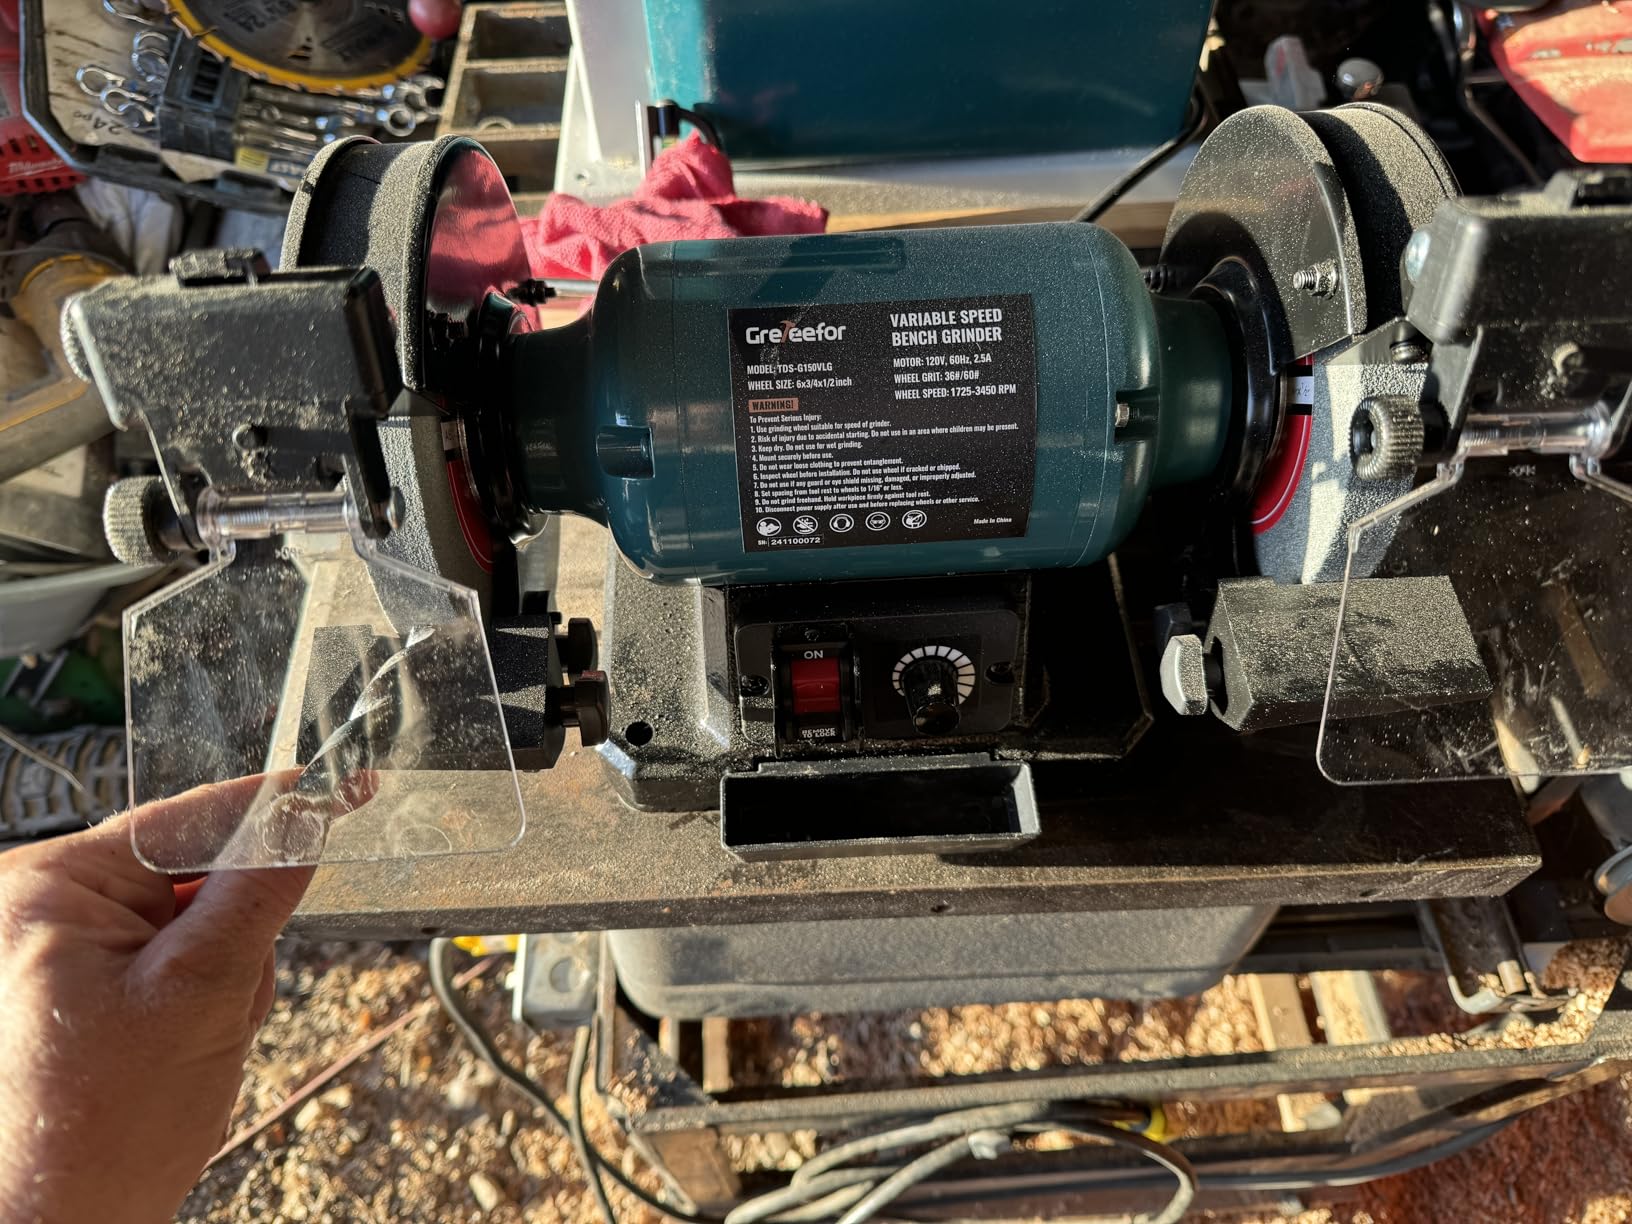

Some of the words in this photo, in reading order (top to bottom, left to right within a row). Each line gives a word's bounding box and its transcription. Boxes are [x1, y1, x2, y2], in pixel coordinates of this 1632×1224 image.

[890, 311, 956, 328] VARIABLE
[960, 308, 1002, 324] SPEED
[892, 330, 937, 347] BENCH
[942, 327, 1002, 344] GRINDER
[893, 357, 924, 367] MOTOR:
[926, 356, 948, 366] 120V,
[949, 354, 972, 365] 60Hz,
[974, 353, 992, 363] 2.5A
[747, 365, 776, 374] MODEL:
[777, 362, 832, 373] TDS-G150VLG
[894, 373, 919, 383] WHEEL
[922, 372, 942, 382] GRIT:
[945, 370, 979, 381] 36#/60#
[748, 380, 774, 390] WHEEL
[776, 380, 794, 389] SIZE:
[895, 389, 921, 400] WHEEL
[922, 388, 949, 398] SPEED:
[951, 385, 996, 397] 1725-3450
[998, 384, 1016, 394] RPM
[752, 400, 793, 410] WARNING!
[804, 650, 824, 660] ON
